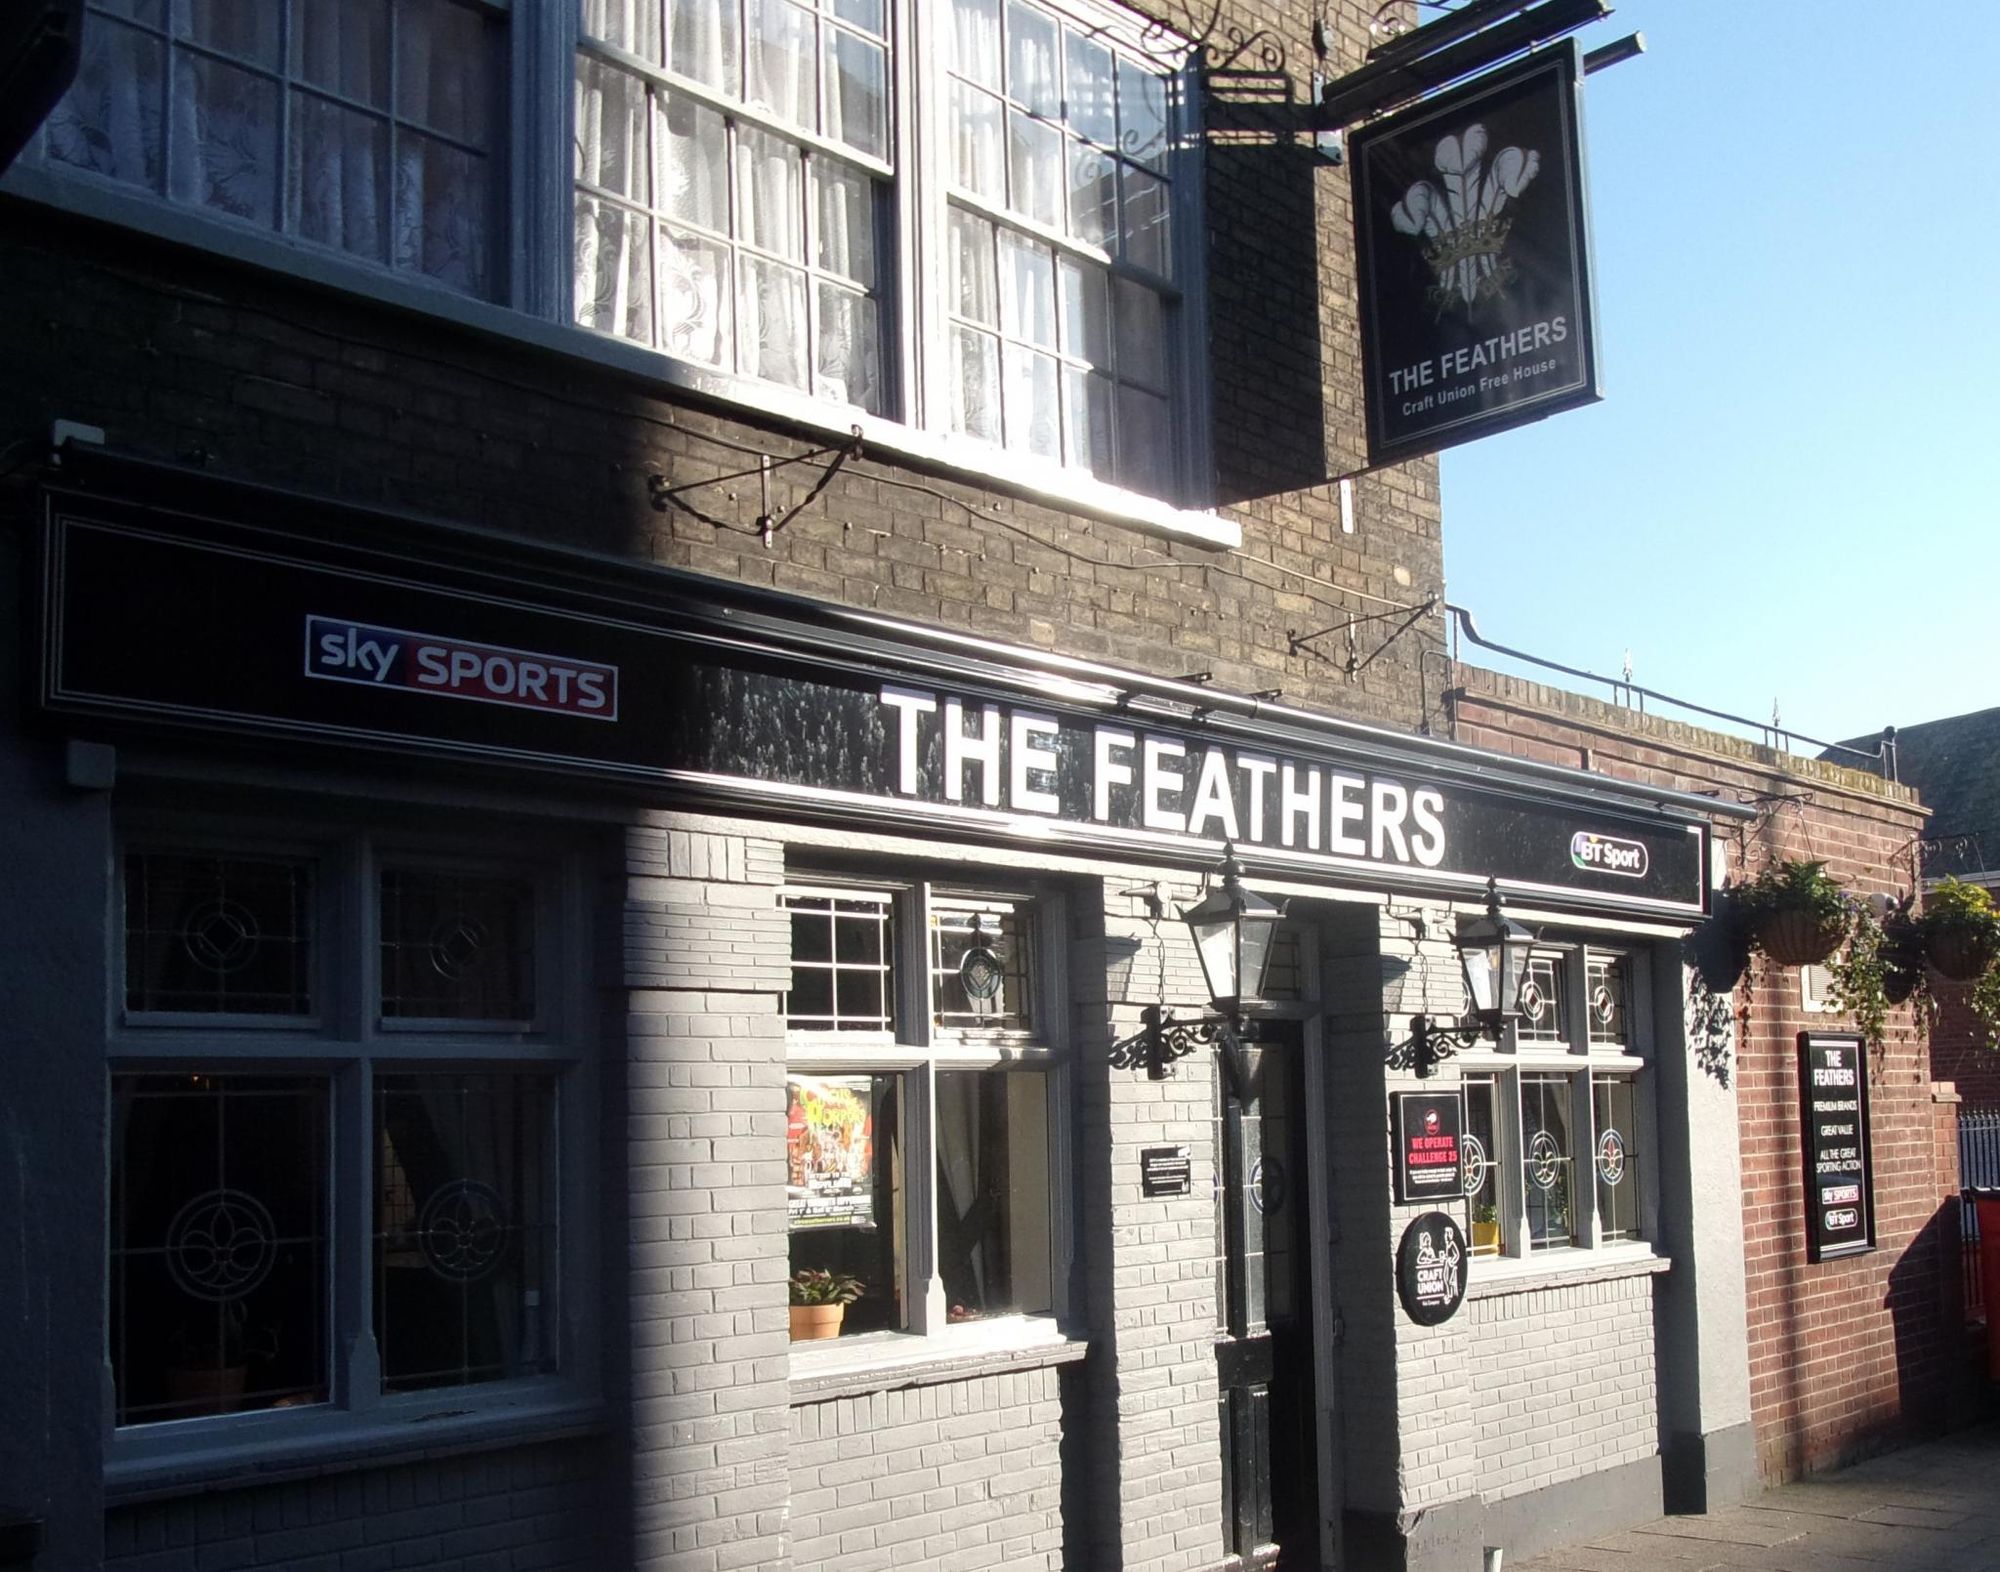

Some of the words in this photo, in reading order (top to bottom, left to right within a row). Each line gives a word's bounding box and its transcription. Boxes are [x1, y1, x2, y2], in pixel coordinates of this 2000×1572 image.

[1389, 360, 1433, 394] THE
[1441, 316, 1567, 379] FEATHERS
[1402, 396, 1433, 416] Craft
[1438, 383, 1475, 405] Union
[1479, 373, 1508, 391] Free
[1513, 358, 1556, 380] House
[320, 627, 399, 682] sky
[417, 645, 607, 709] SPORTS
[880, 684, 1060, 815] THE
[1093, 723, 1446, 867] FEATHERS
[1581, 840, 1603, 862] BT
[1604, 842, 1640, 869] Sport
[1825, 1050, 1842, 1067] THE
[1813, 1068, 1855, 1086] FEATHERS
[1813, 1101, 1837, 1111] PREMIUM
[1837, 1100, 1858, 1111] BRANDS
[1820, 1125, 1837, 1136] GREAT
[1837, 1124, 1854, 1135] VALUE
[1412, 1137, 1423, 1149] WE
[1424, 1136, 1454, 1149] OPERATE
[1408, 1151, 1447, 1165] CHALLENGE
[1448, 1150, 1458, 1162] 25
[1820, 1149, 1829, 1160] ALL
[1829, 1148, 1840, 1159] THE
[1840, 1147, 1857, 1158] GREAT
[1816, 1162, 1841, 1173] SPORTING
[1842, 1160, 1861, 1171] ACTION
[1834, 1188, 1857, 1201] SPORTS
[1829, 1212, 1838, 1226] BT
[1839, 1211, 1854, 1226] Sport
[1417, 1268, 1443, 1282] CRAFT
[1417, 1280, 1444, 1294] UNION
